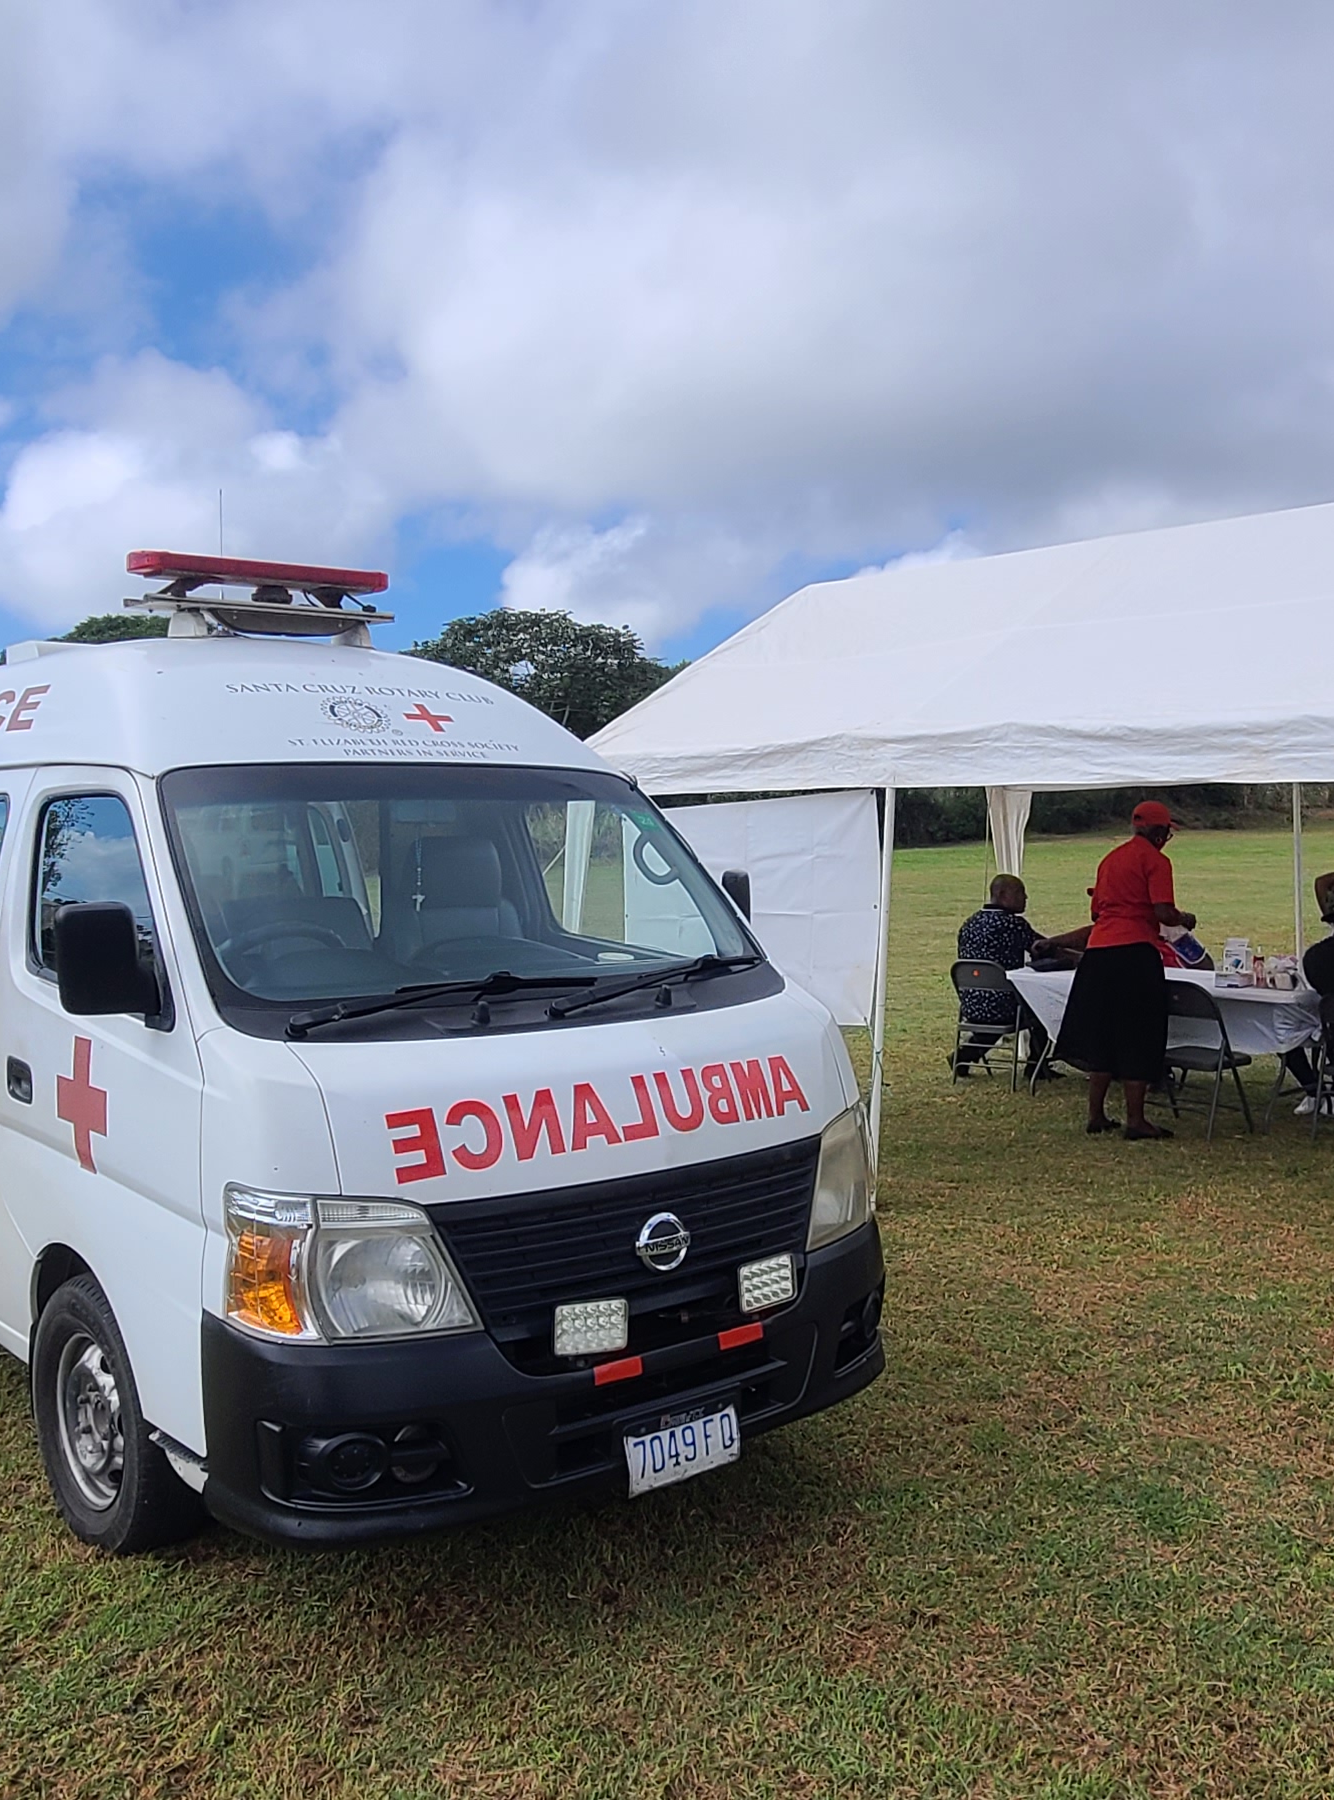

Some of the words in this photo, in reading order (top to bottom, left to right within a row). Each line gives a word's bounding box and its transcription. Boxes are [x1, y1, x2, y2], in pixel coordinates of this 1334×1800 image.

[226, 683, 299, 694] SANTA
[302, 684, 362, 695] CRUZ
[364, 686, 440, 700] ROTARY
[445, 692, 494, 705] CLUB
[391, 738, 420, 748] RED
[422, 740, 466, 749] CROSS
[467, 741, 520, 752] SOCIETY
[343, 748, 415, 757] PARTNERS
[435, 750, 490, 760] SERVICE
[645, 1233, 688, 1253] NISSAN
